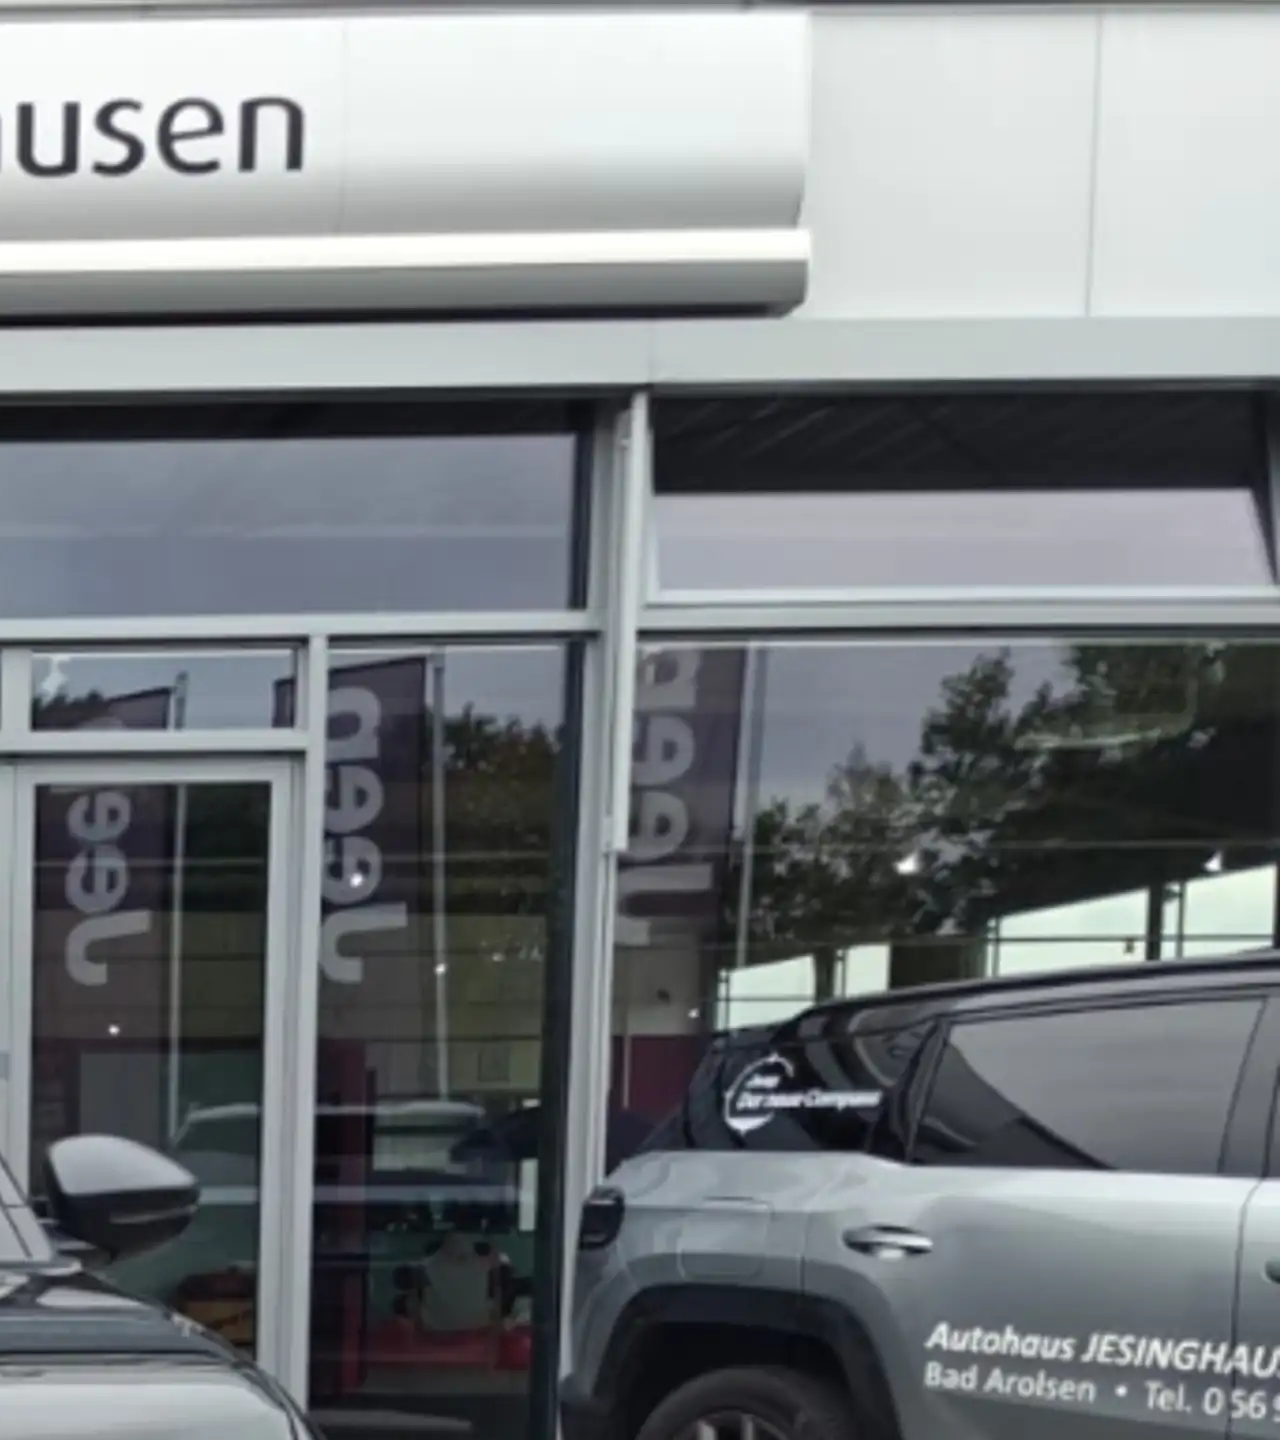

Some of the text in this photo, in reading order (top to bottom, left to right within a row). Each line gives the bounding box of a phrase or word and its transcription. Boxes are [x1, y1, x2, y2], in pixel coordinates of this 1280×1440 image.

[924, 1321, 1280, 1380] Autohaus JESINGHAU
[924, 1360, 979, 1391] Bad
[984, 1368, 1097, 1404] Arolsen
[1144, 1380, 1192, 1414] Tel.
